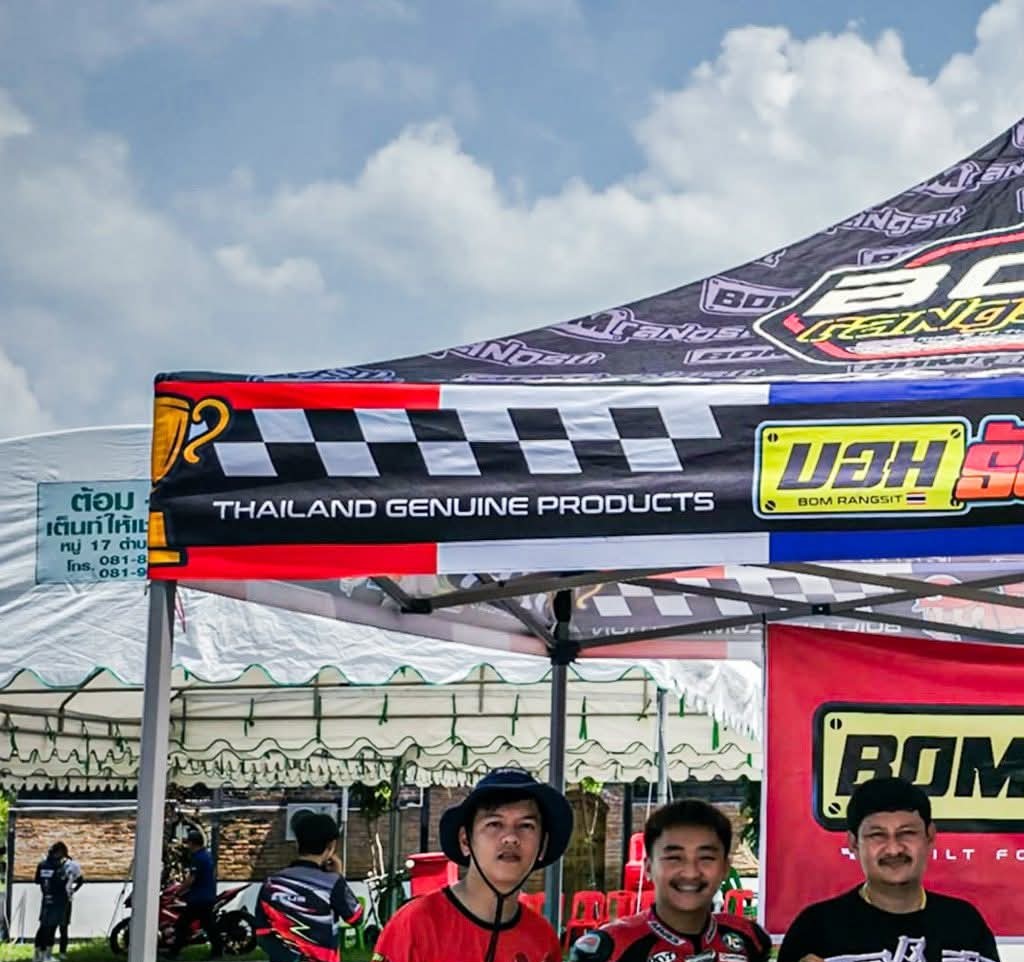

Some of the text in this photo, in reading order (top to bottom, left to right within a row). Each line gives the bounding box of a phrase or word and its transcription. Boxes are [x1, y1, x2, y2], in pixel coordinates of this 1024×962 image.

[71, 487, 134, 512] ต้อม
[213, 491, 715, 520] THAILAND GENUINE PRODUCTS
[797, 493, 901, 507] BOM RANGSIT
[91, 540, 111, 551] 17
[99, 555, 147, 566] 081-8
[99, 568, 147, 578] 081-9
